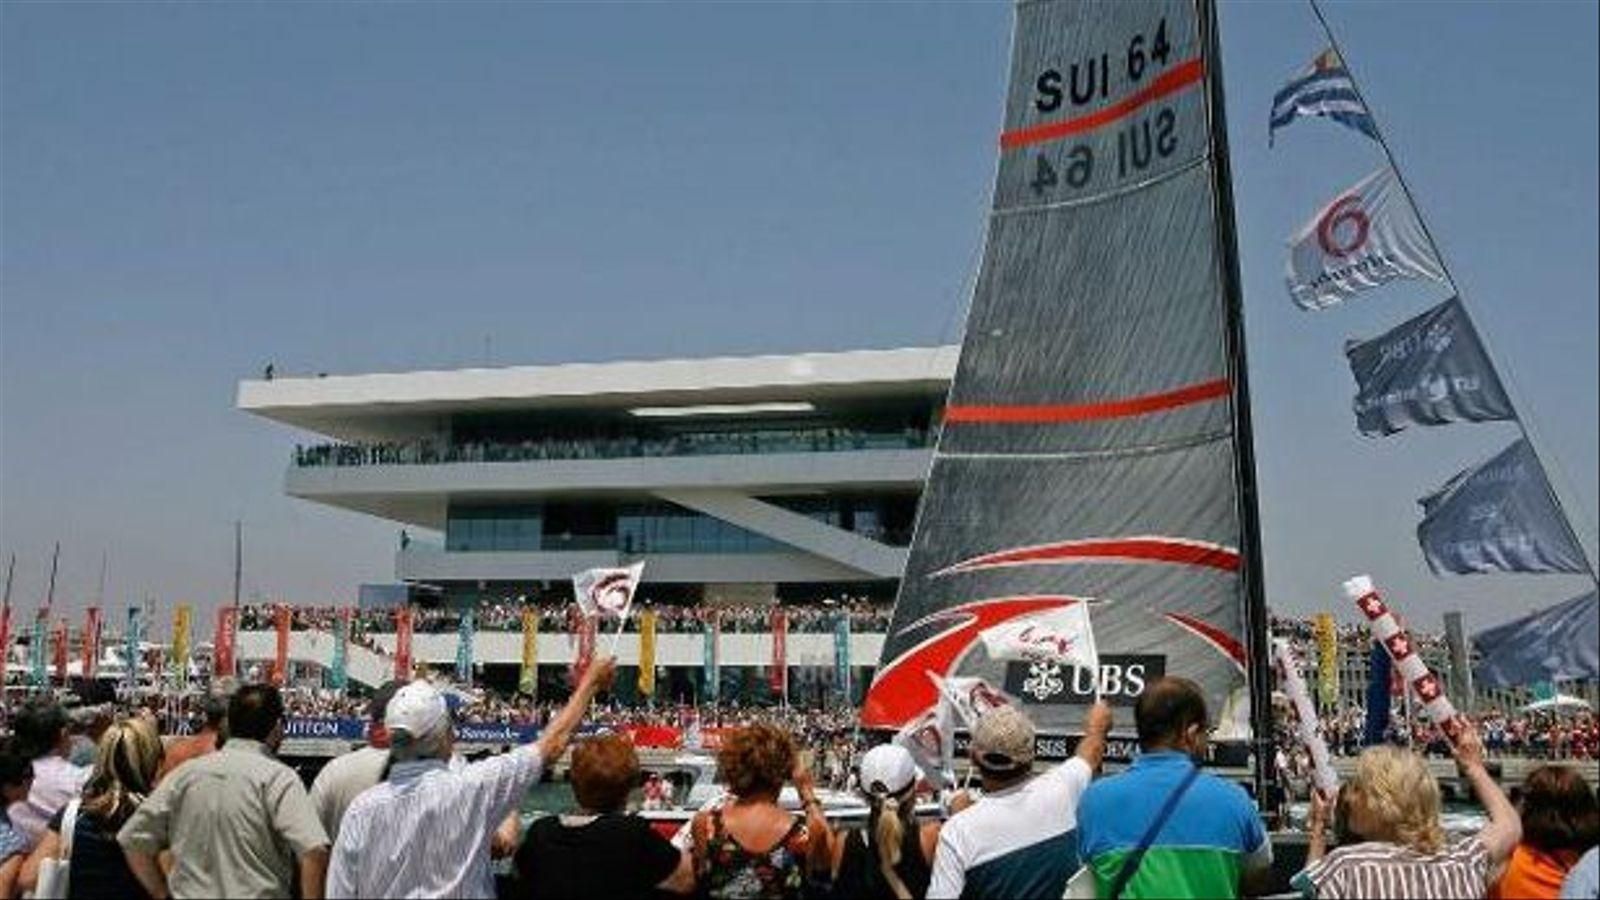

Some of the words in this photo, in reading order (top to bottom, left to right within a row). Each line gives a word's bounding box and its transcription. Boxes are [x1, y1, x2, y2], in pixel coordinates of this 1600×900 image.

[1035, 53, 1109, 113] SUI
[1127, 18, 1171, 81] 64
[1072, 664, 1146, 697] UBS
